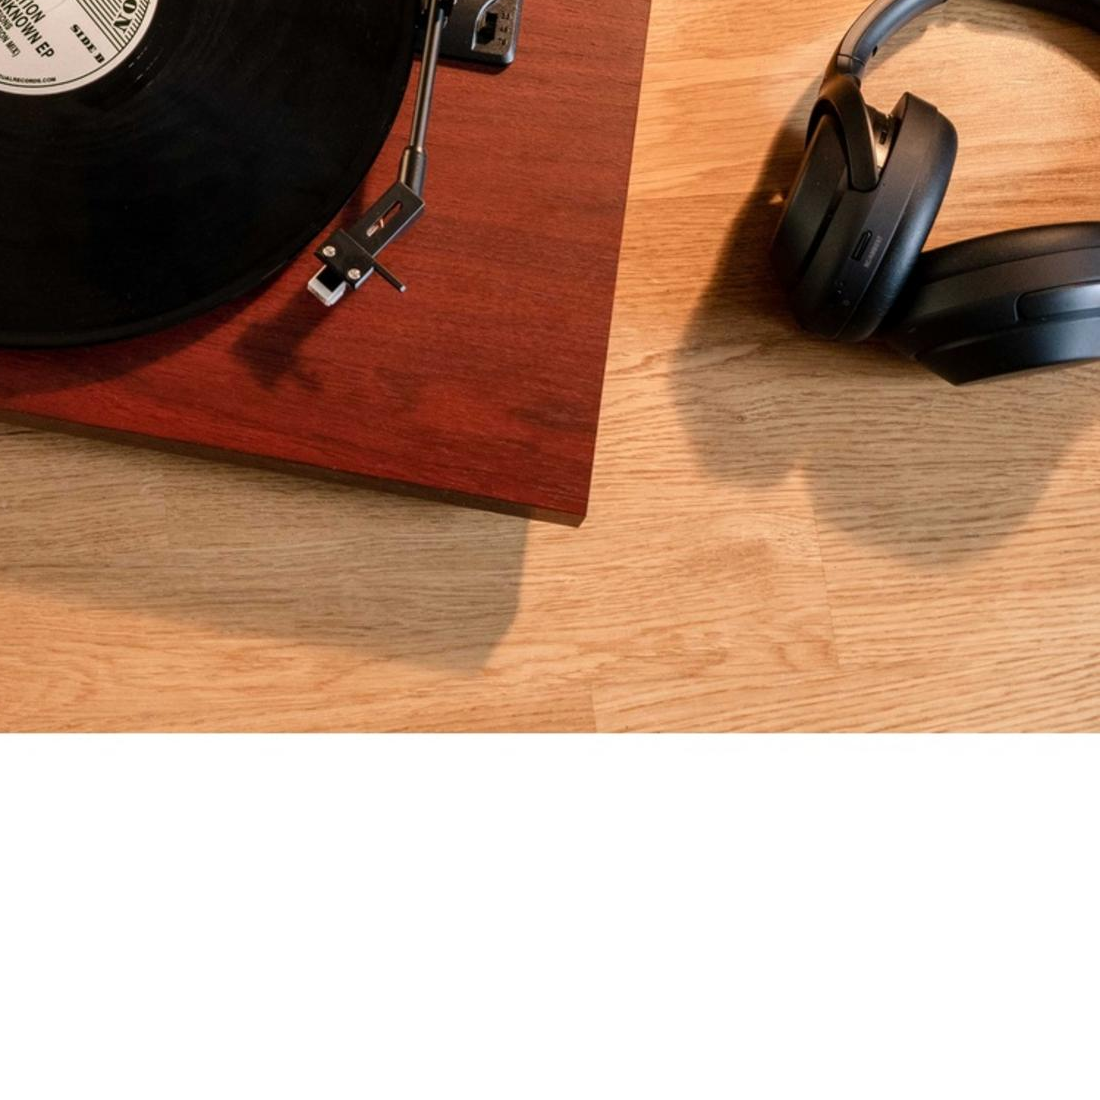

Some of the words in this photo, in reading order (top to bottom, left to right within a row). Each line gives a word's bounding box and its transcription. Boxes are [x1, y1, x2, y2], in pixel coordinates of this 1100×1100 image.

[5, 40, 21, 58] MIX)
[35, 41, 55, 58] EP
[70, 24, 97, 53] SIDE
[94, 53, 105, 63] B
